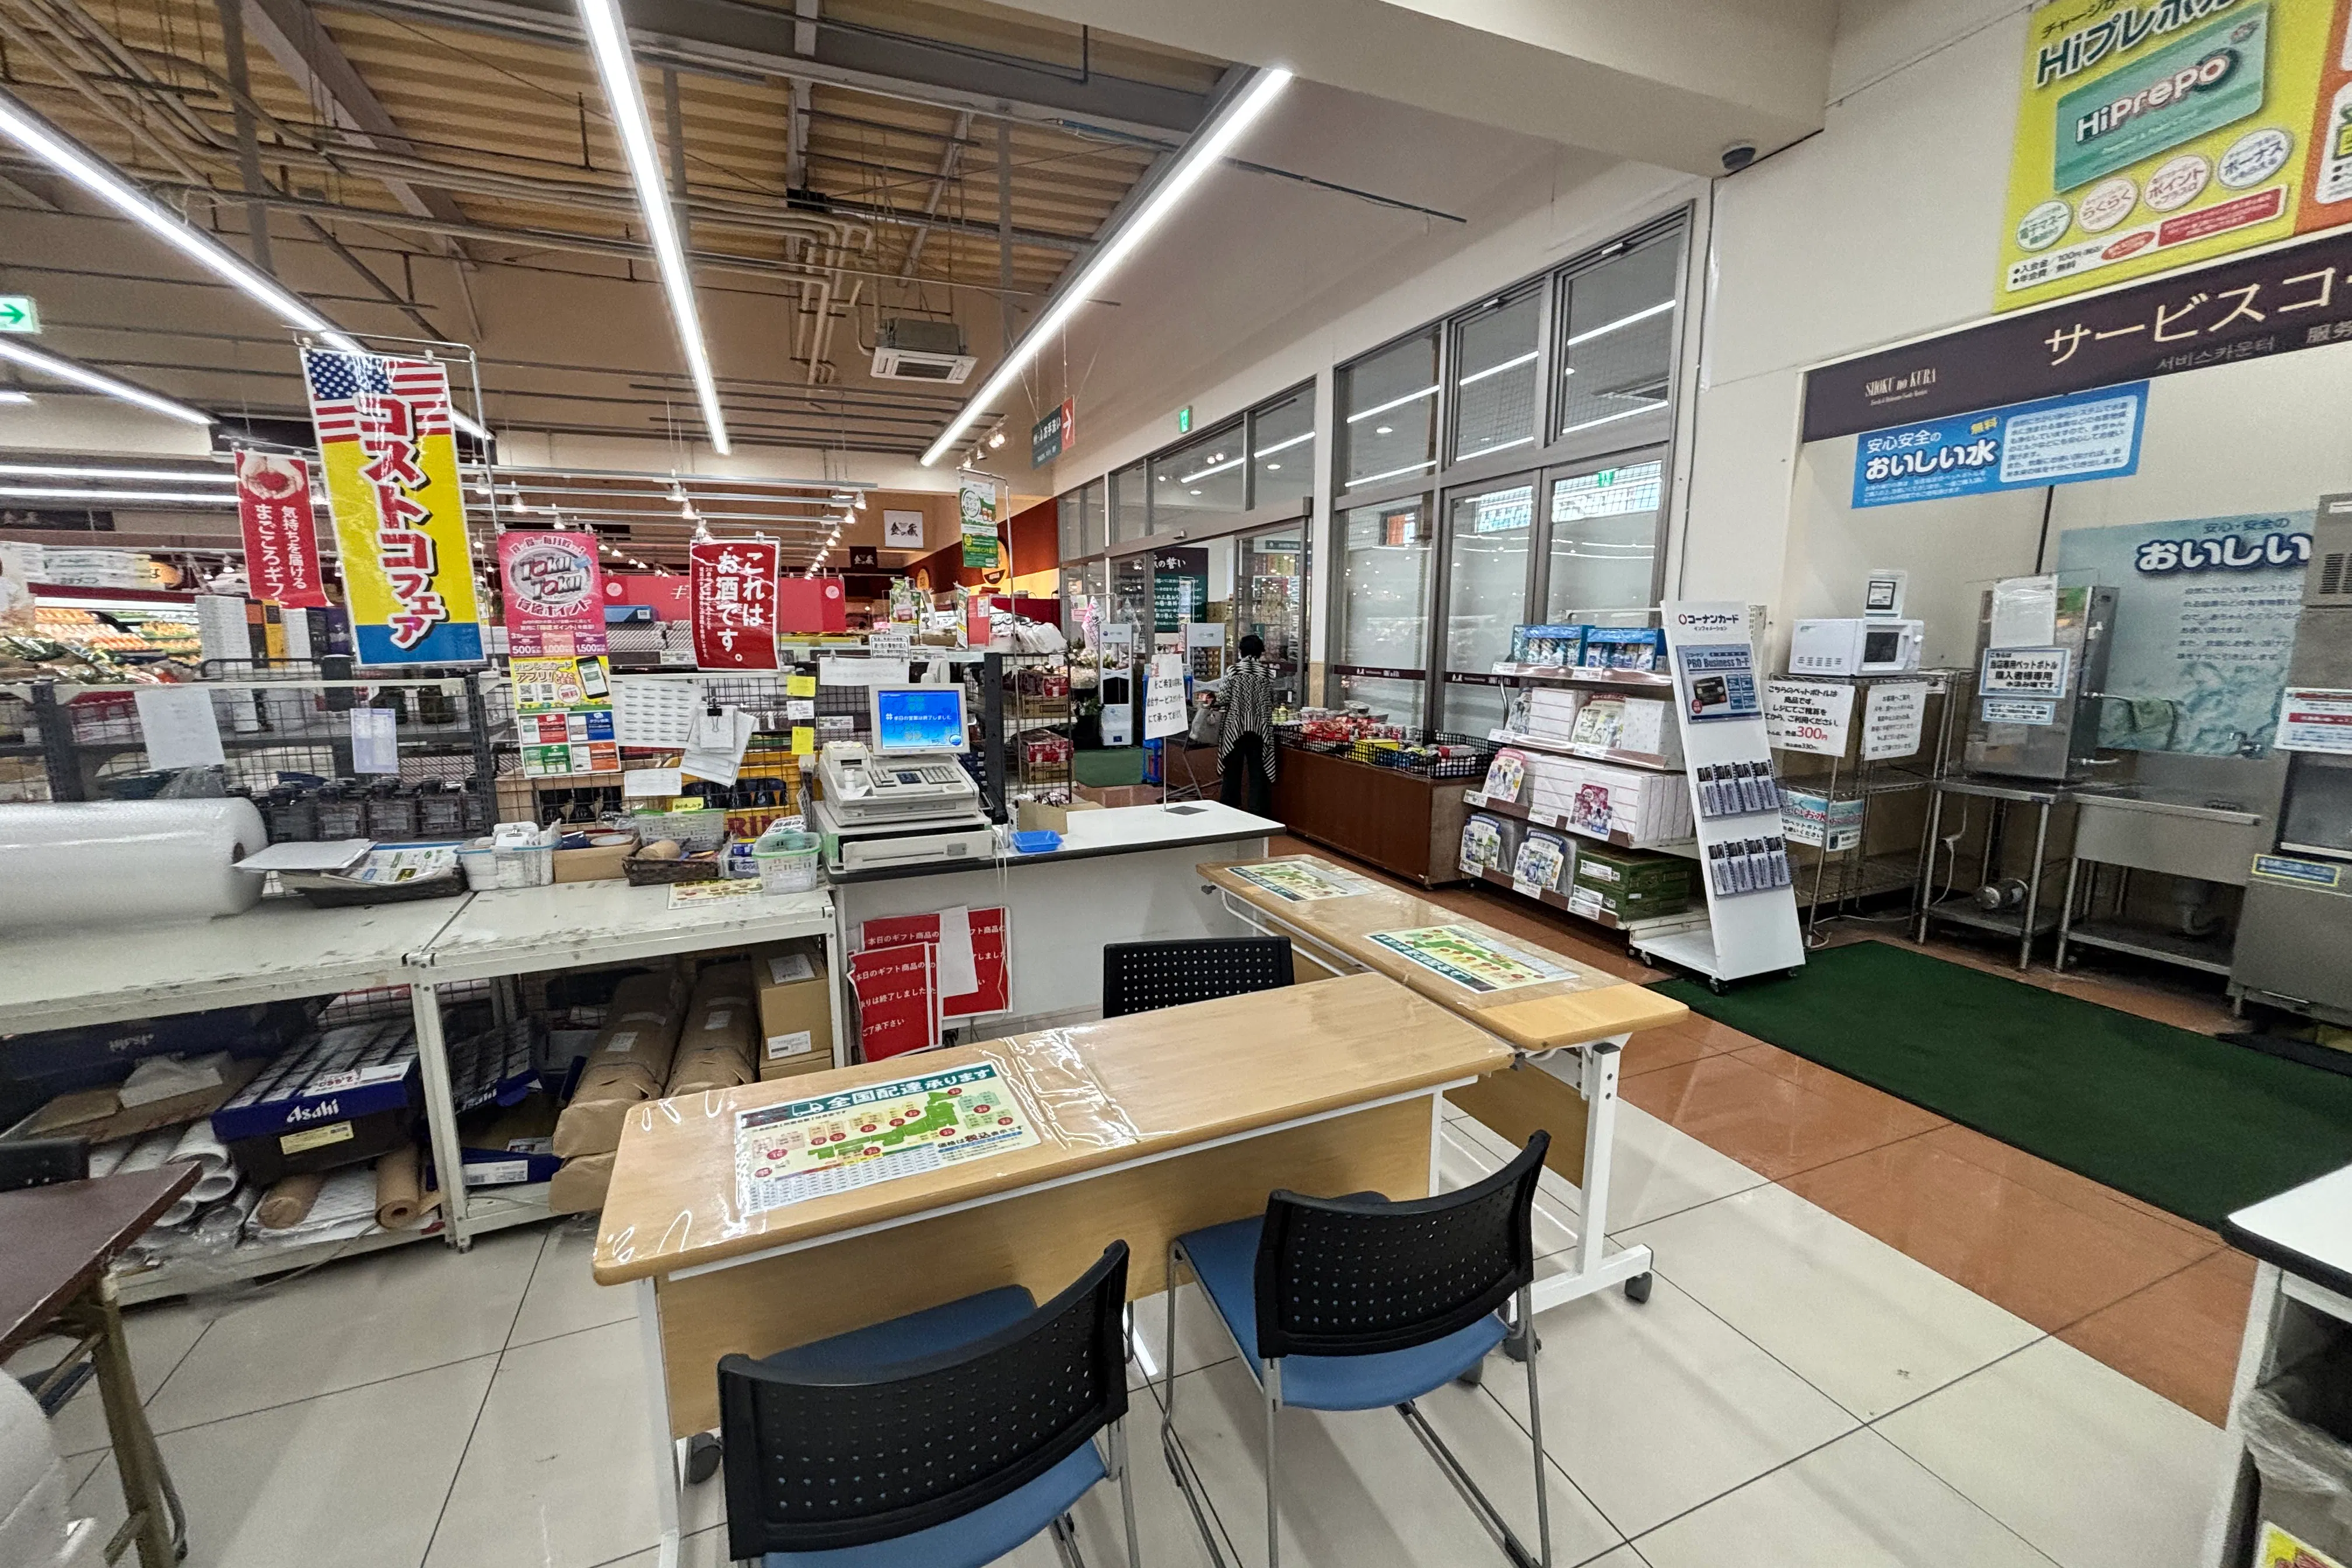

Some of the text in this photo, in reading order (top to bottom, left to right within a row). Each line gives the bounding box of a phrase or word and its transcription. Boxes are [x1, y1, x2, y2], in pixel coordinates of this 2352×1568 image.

[2044, 267, 2352, 366] サービスコ
[1867, 430, 1943, 454] 安心安全の
[1865, 438, 1999, 482] おいしい水
[358, 396, 442, 643] コストコフェア
[281, 506, 307, 589] 気持ちを届ける
[2136, 532, 2314, 572] おいしい
[742, 552, 765, 626] これは
[716, 550, 743, 662] お酒です。
[1688, 614, 1740, 624] コーナンカード
[513, 645, 532, 654] 500
[1687, 659, 1702, 668] PRO
[1704, 658, 1735, 668] Business
[1768, 685, 1838, 697] こちらのペットボトルは
[1784, 696, 1815, 705] 商品です。
[868, 930, 940, 946] 本日のギフト商品の
[856, 961, 925, 982] 本日のギフト商品の
[862, 1018, 905, 1037] ご了承下さい
[827, 1067, 992, 1109] 全国配達承ります
[286, 1098, 340, 1124] Asahi
